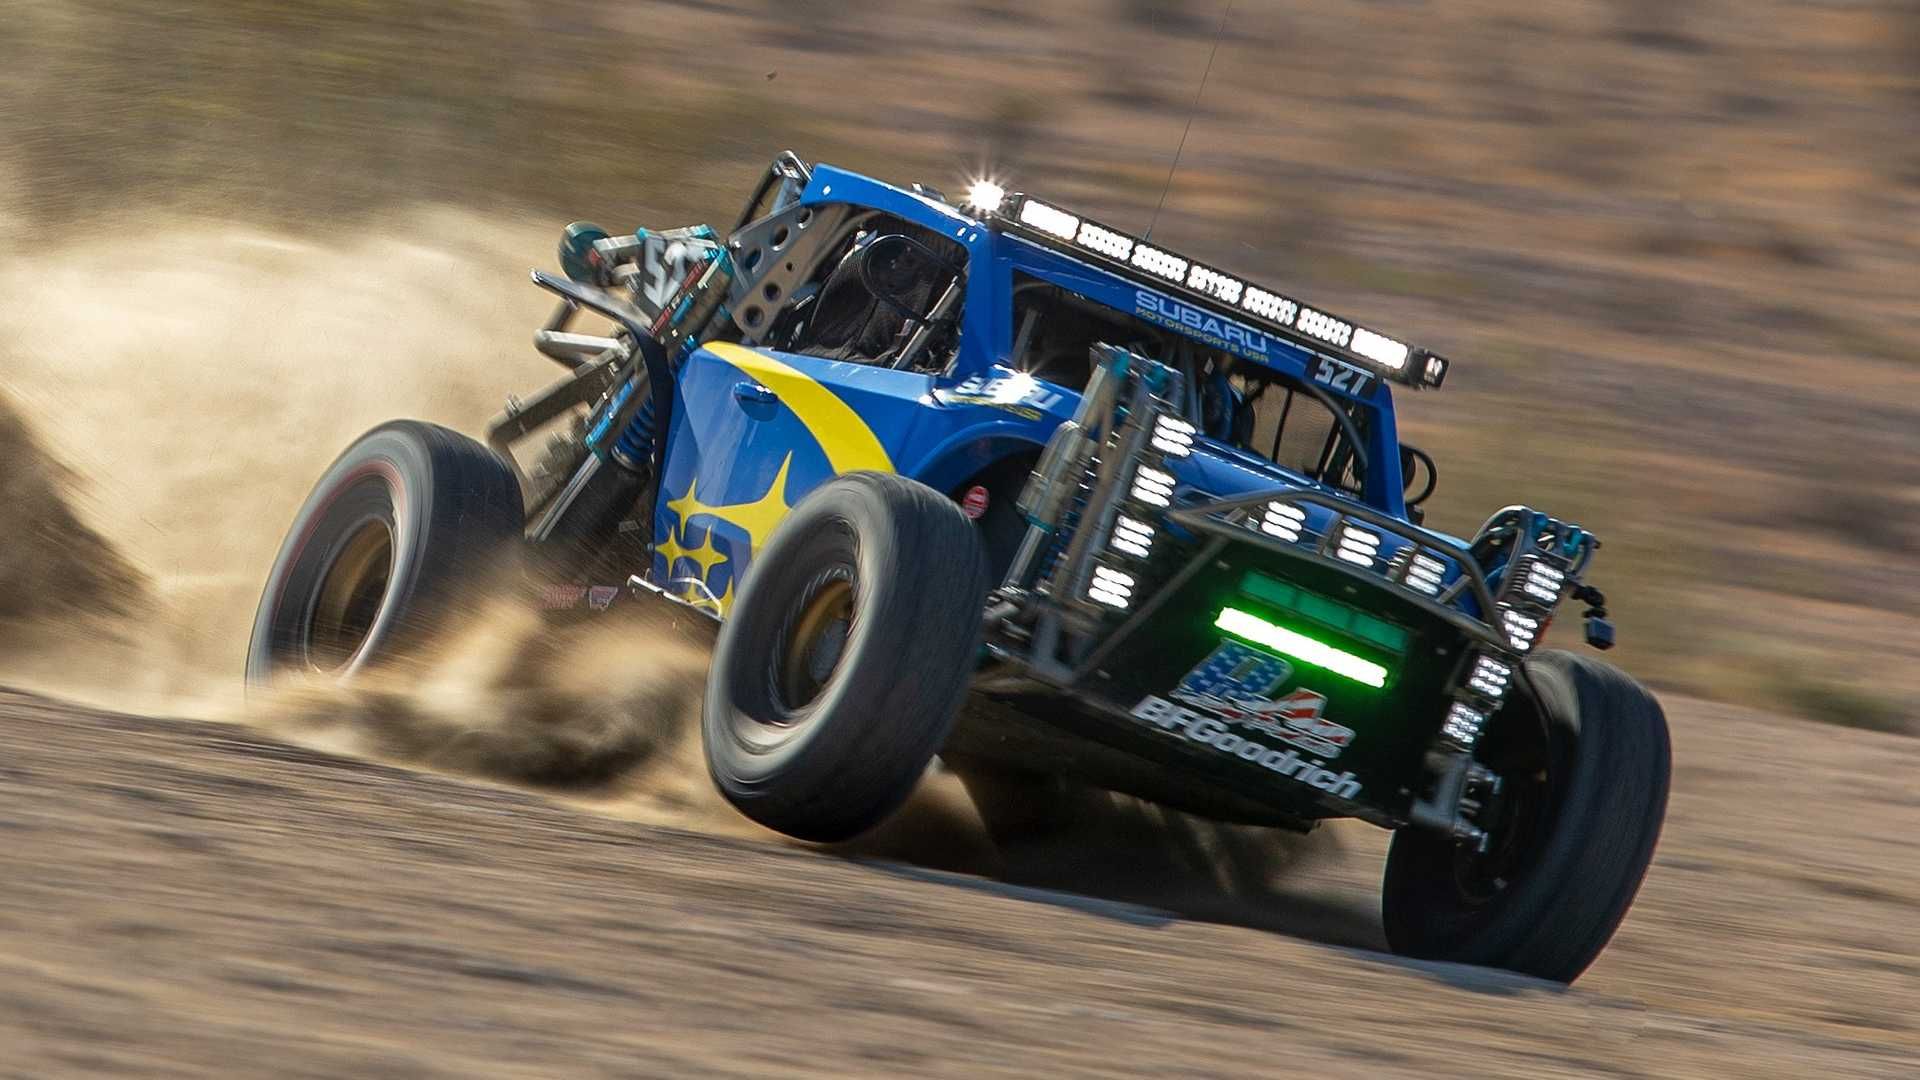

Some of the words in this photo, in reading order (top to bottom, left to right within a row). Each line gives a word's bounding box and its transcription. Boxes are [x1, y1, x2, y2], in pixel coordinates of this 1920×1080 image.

[1135, 289, 1268, 353] SUBARU
[1135, 306, 1240, 353] MOTORSPORTS
[1242, 348, 1270, 364] USA
[955, 376, 1063, 411] SUBU
[1129, 694, 1363, 799] BFGoodrich
